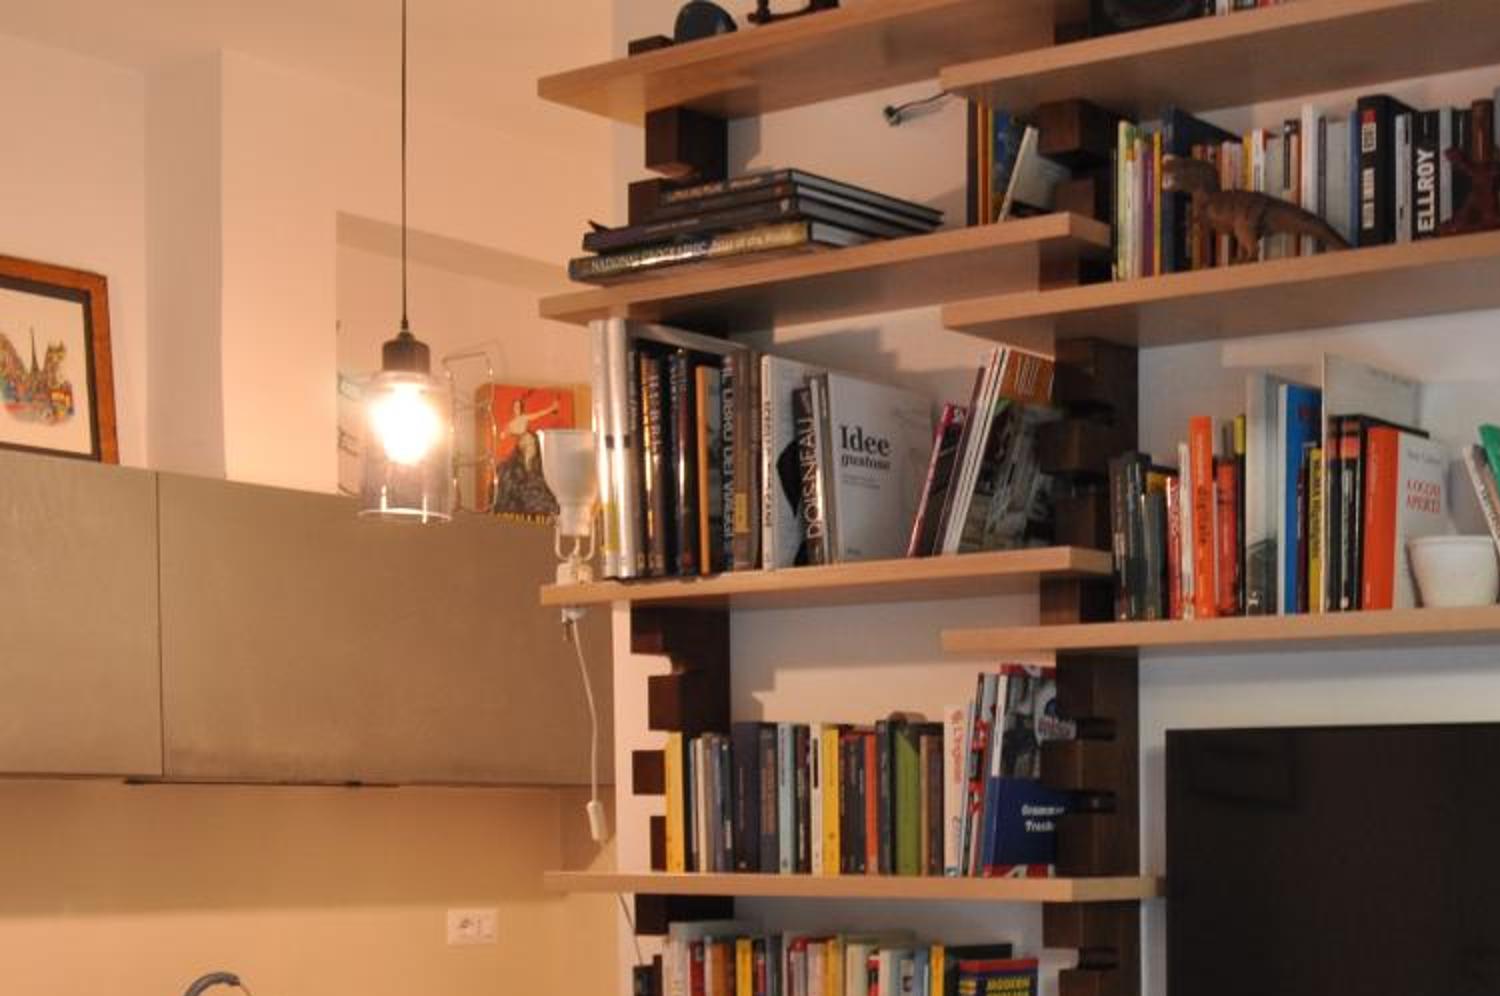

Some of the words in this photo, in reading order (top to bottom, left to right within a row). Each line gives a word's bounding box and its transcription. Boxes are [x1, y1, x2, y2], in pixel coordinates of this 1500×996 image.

[1416, 147, 1436, 232] ELLROY
[798, 415, 822, 540] DOISNEAU
[839, 425, 891, 458] Idee
